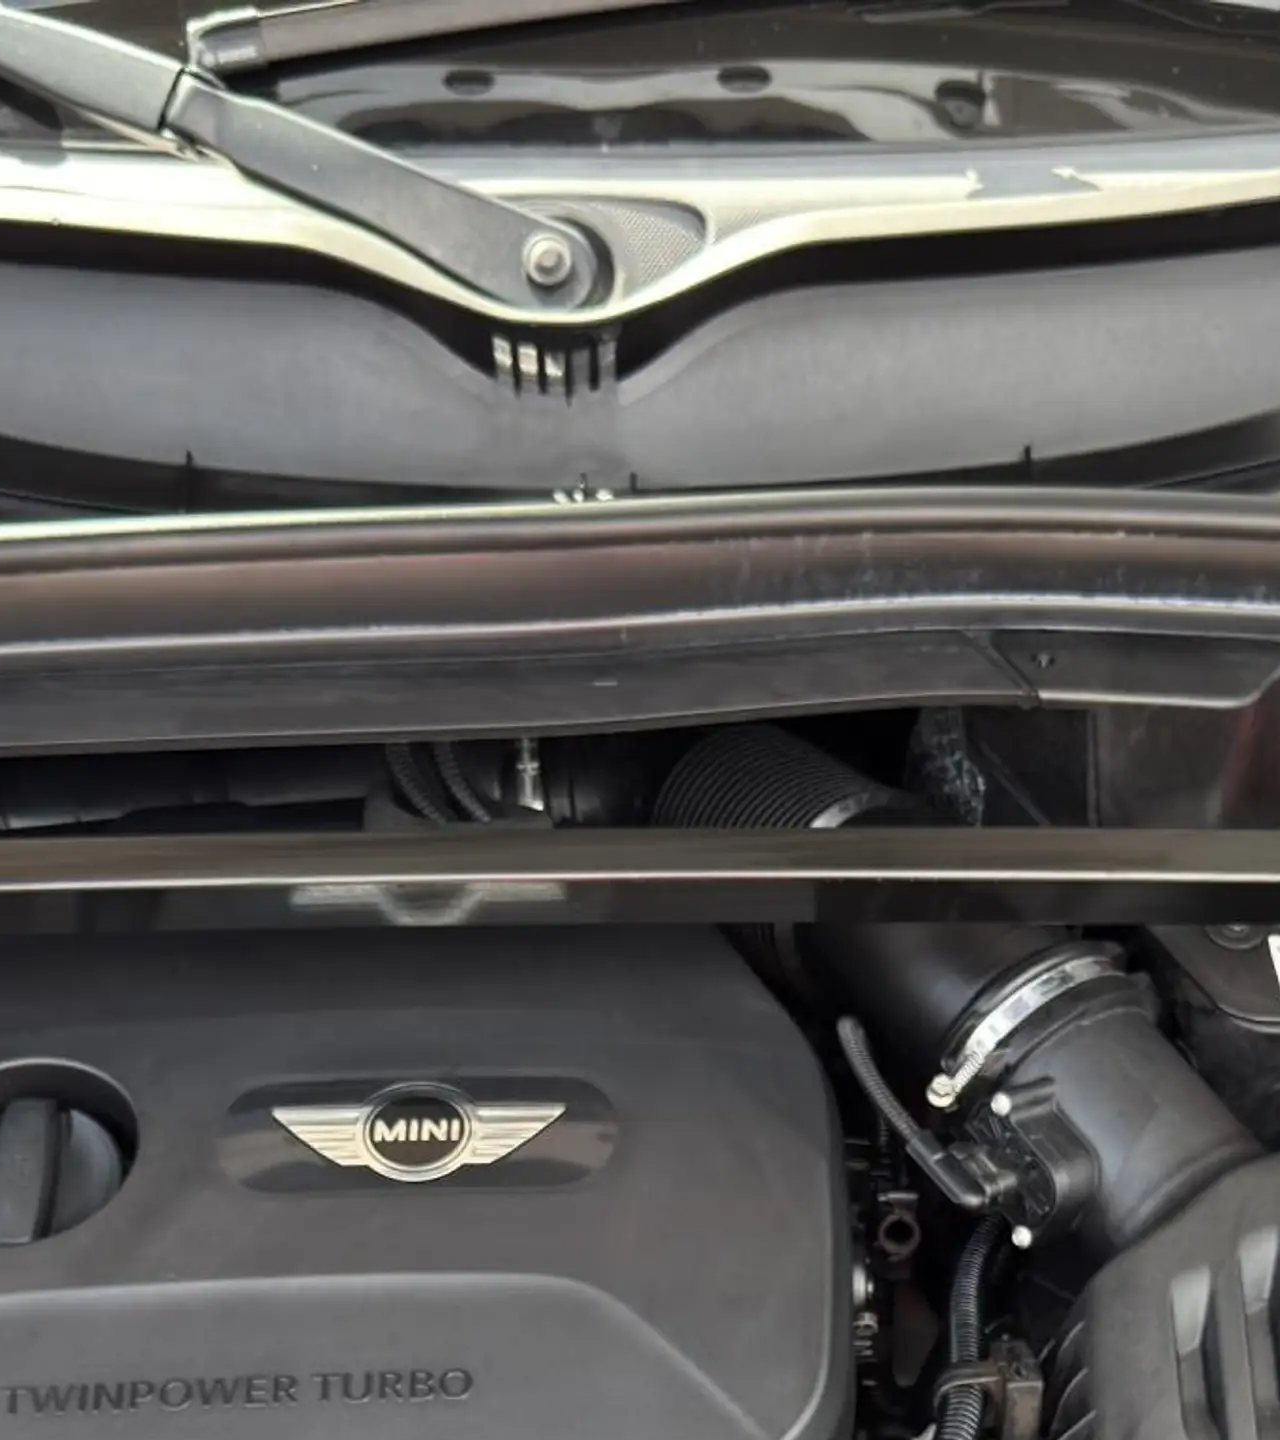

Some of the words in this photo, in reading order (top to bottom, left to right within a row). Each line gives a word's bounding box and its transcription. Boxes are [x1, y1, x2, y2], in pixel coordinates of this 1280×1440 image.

[373, 1117, 461, 1142] MINI
[0, 1373, 299, 1415] TWINPOWER
[312, 1368, 474, 1403] TURBO
